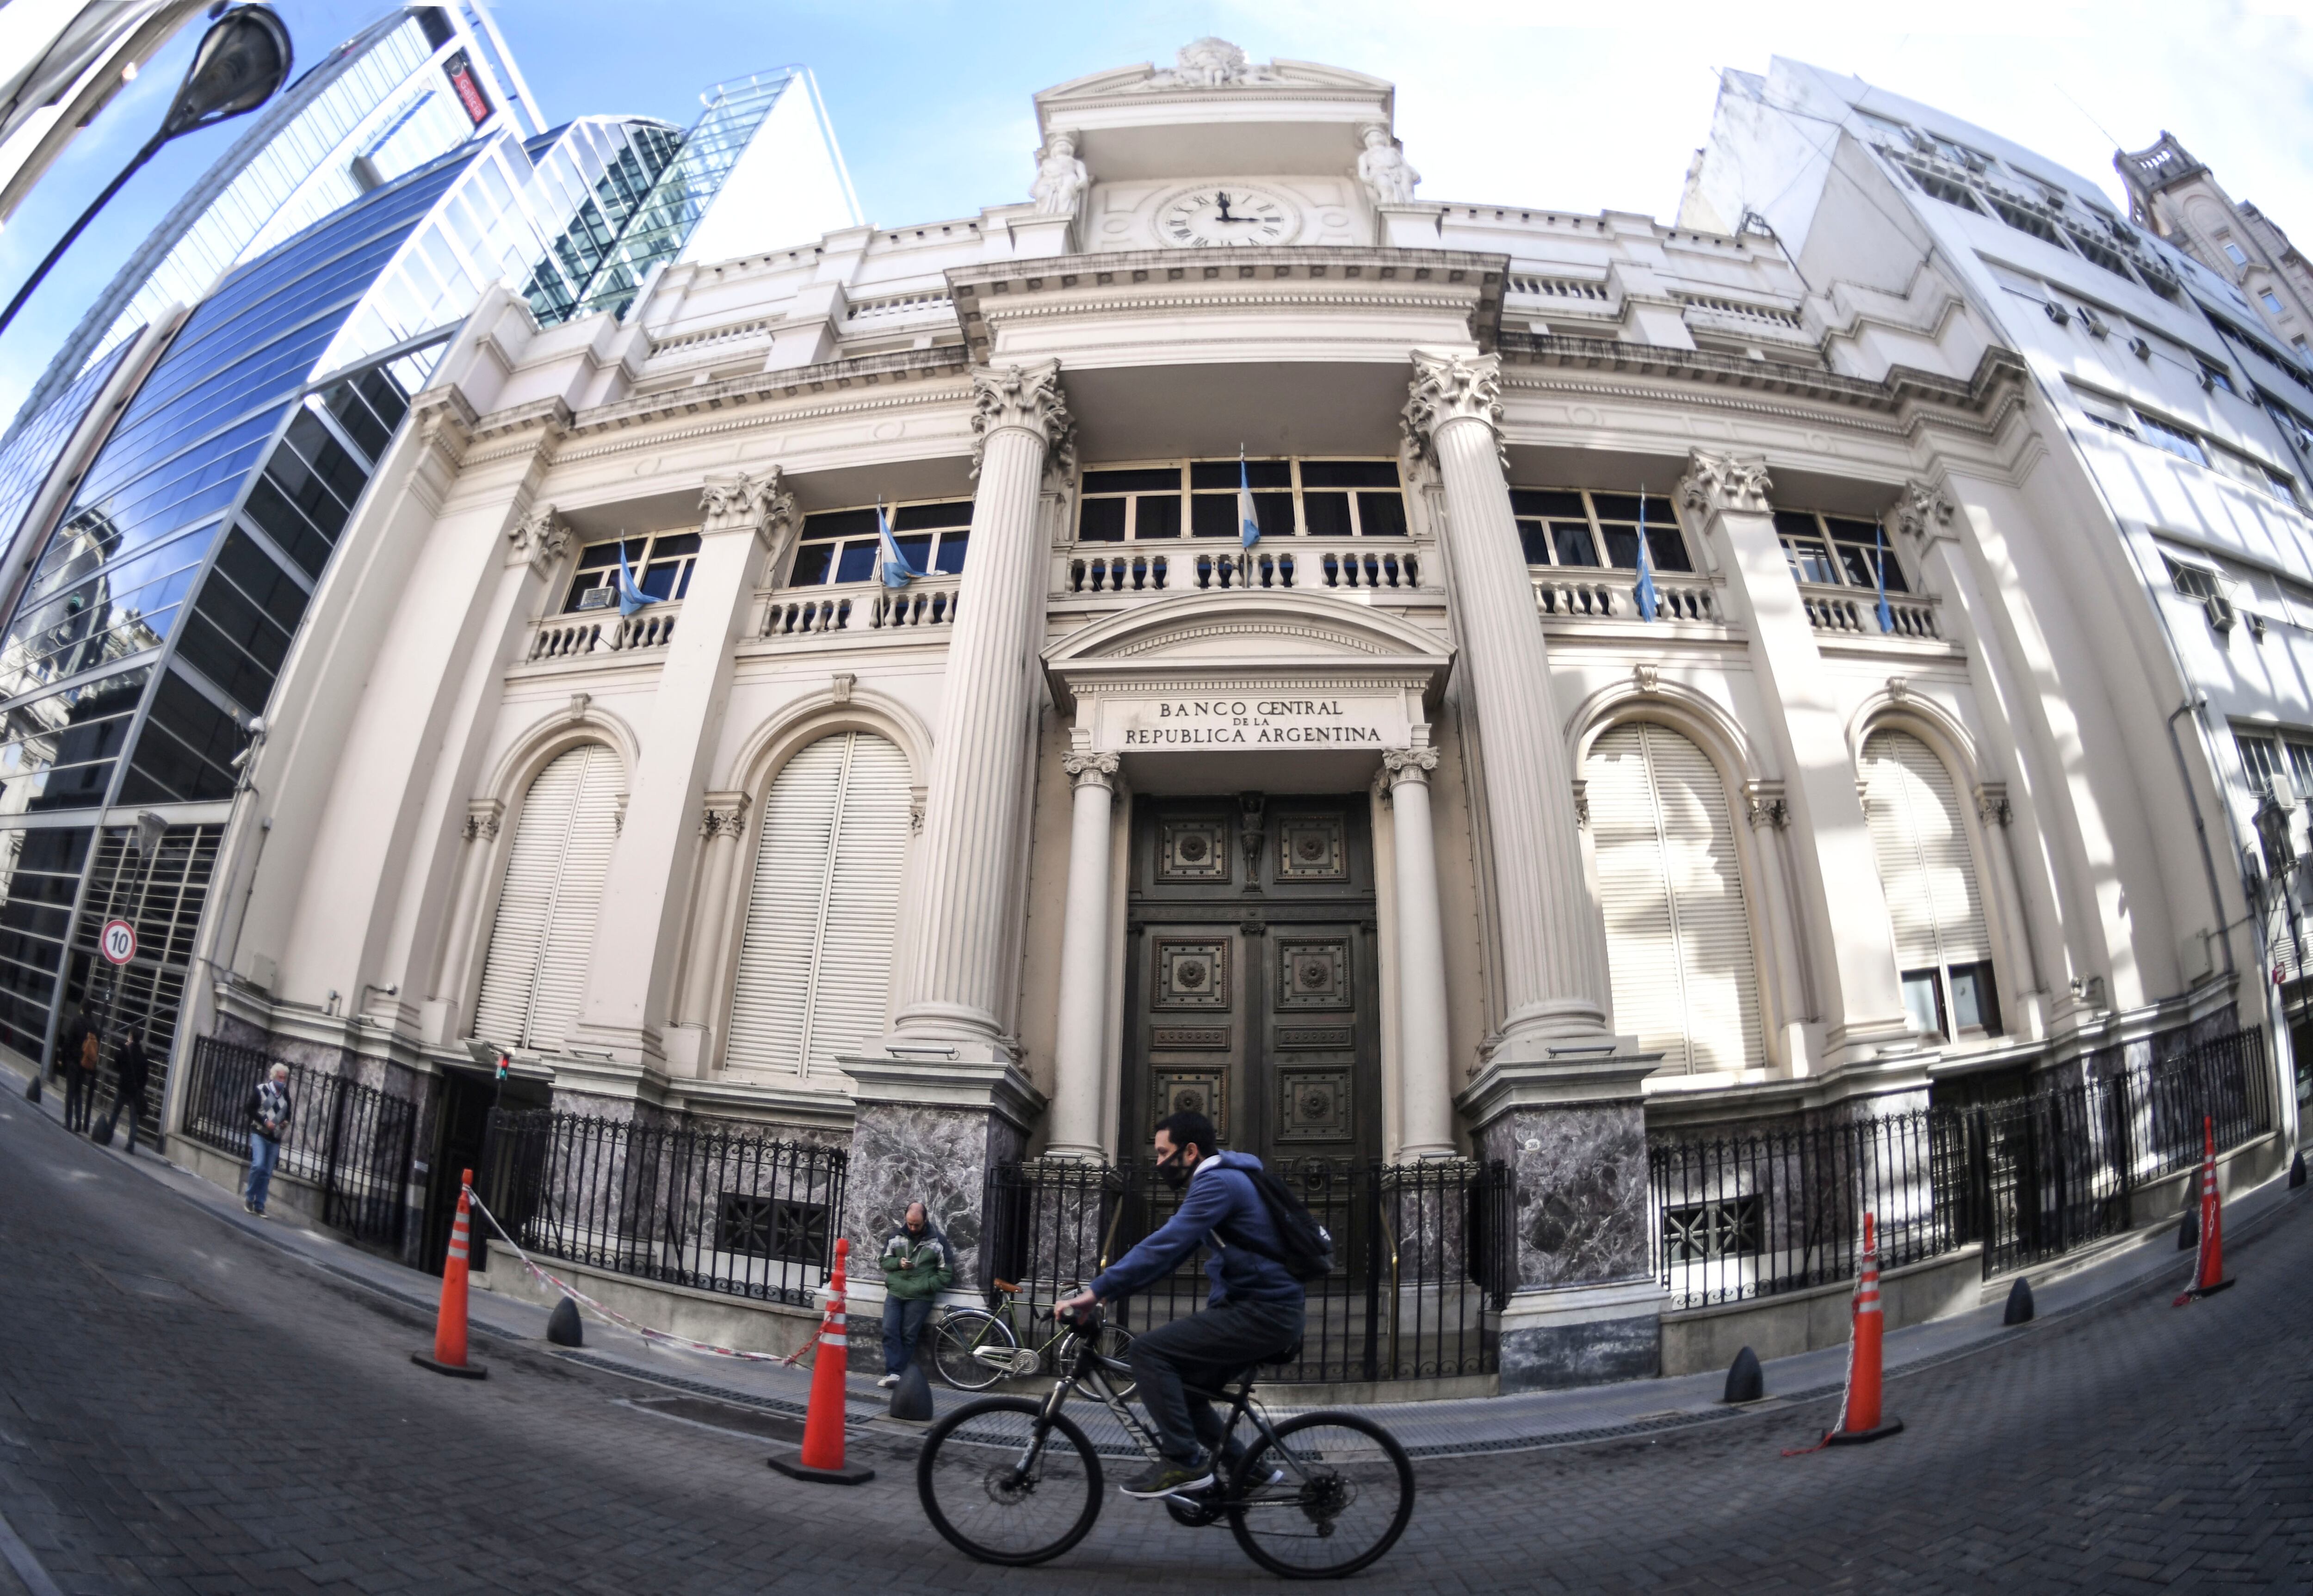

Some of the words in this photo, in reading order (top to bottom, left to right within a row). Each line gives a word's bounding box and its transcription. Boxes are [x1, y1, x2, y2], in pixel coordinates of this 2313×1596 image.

[460, 79, 482, 116] Galicia
[1160, 702, 1246, 717] BANCO
[1257, 701, 1343, 715] CENTRAL
[1126, 728, 1245, 744] REPUBLICA
[1257, 727, 1381, 742] ARGENTINA
[111, 930, 129, 954] 10
[2276, 966, 2284, 981] P
